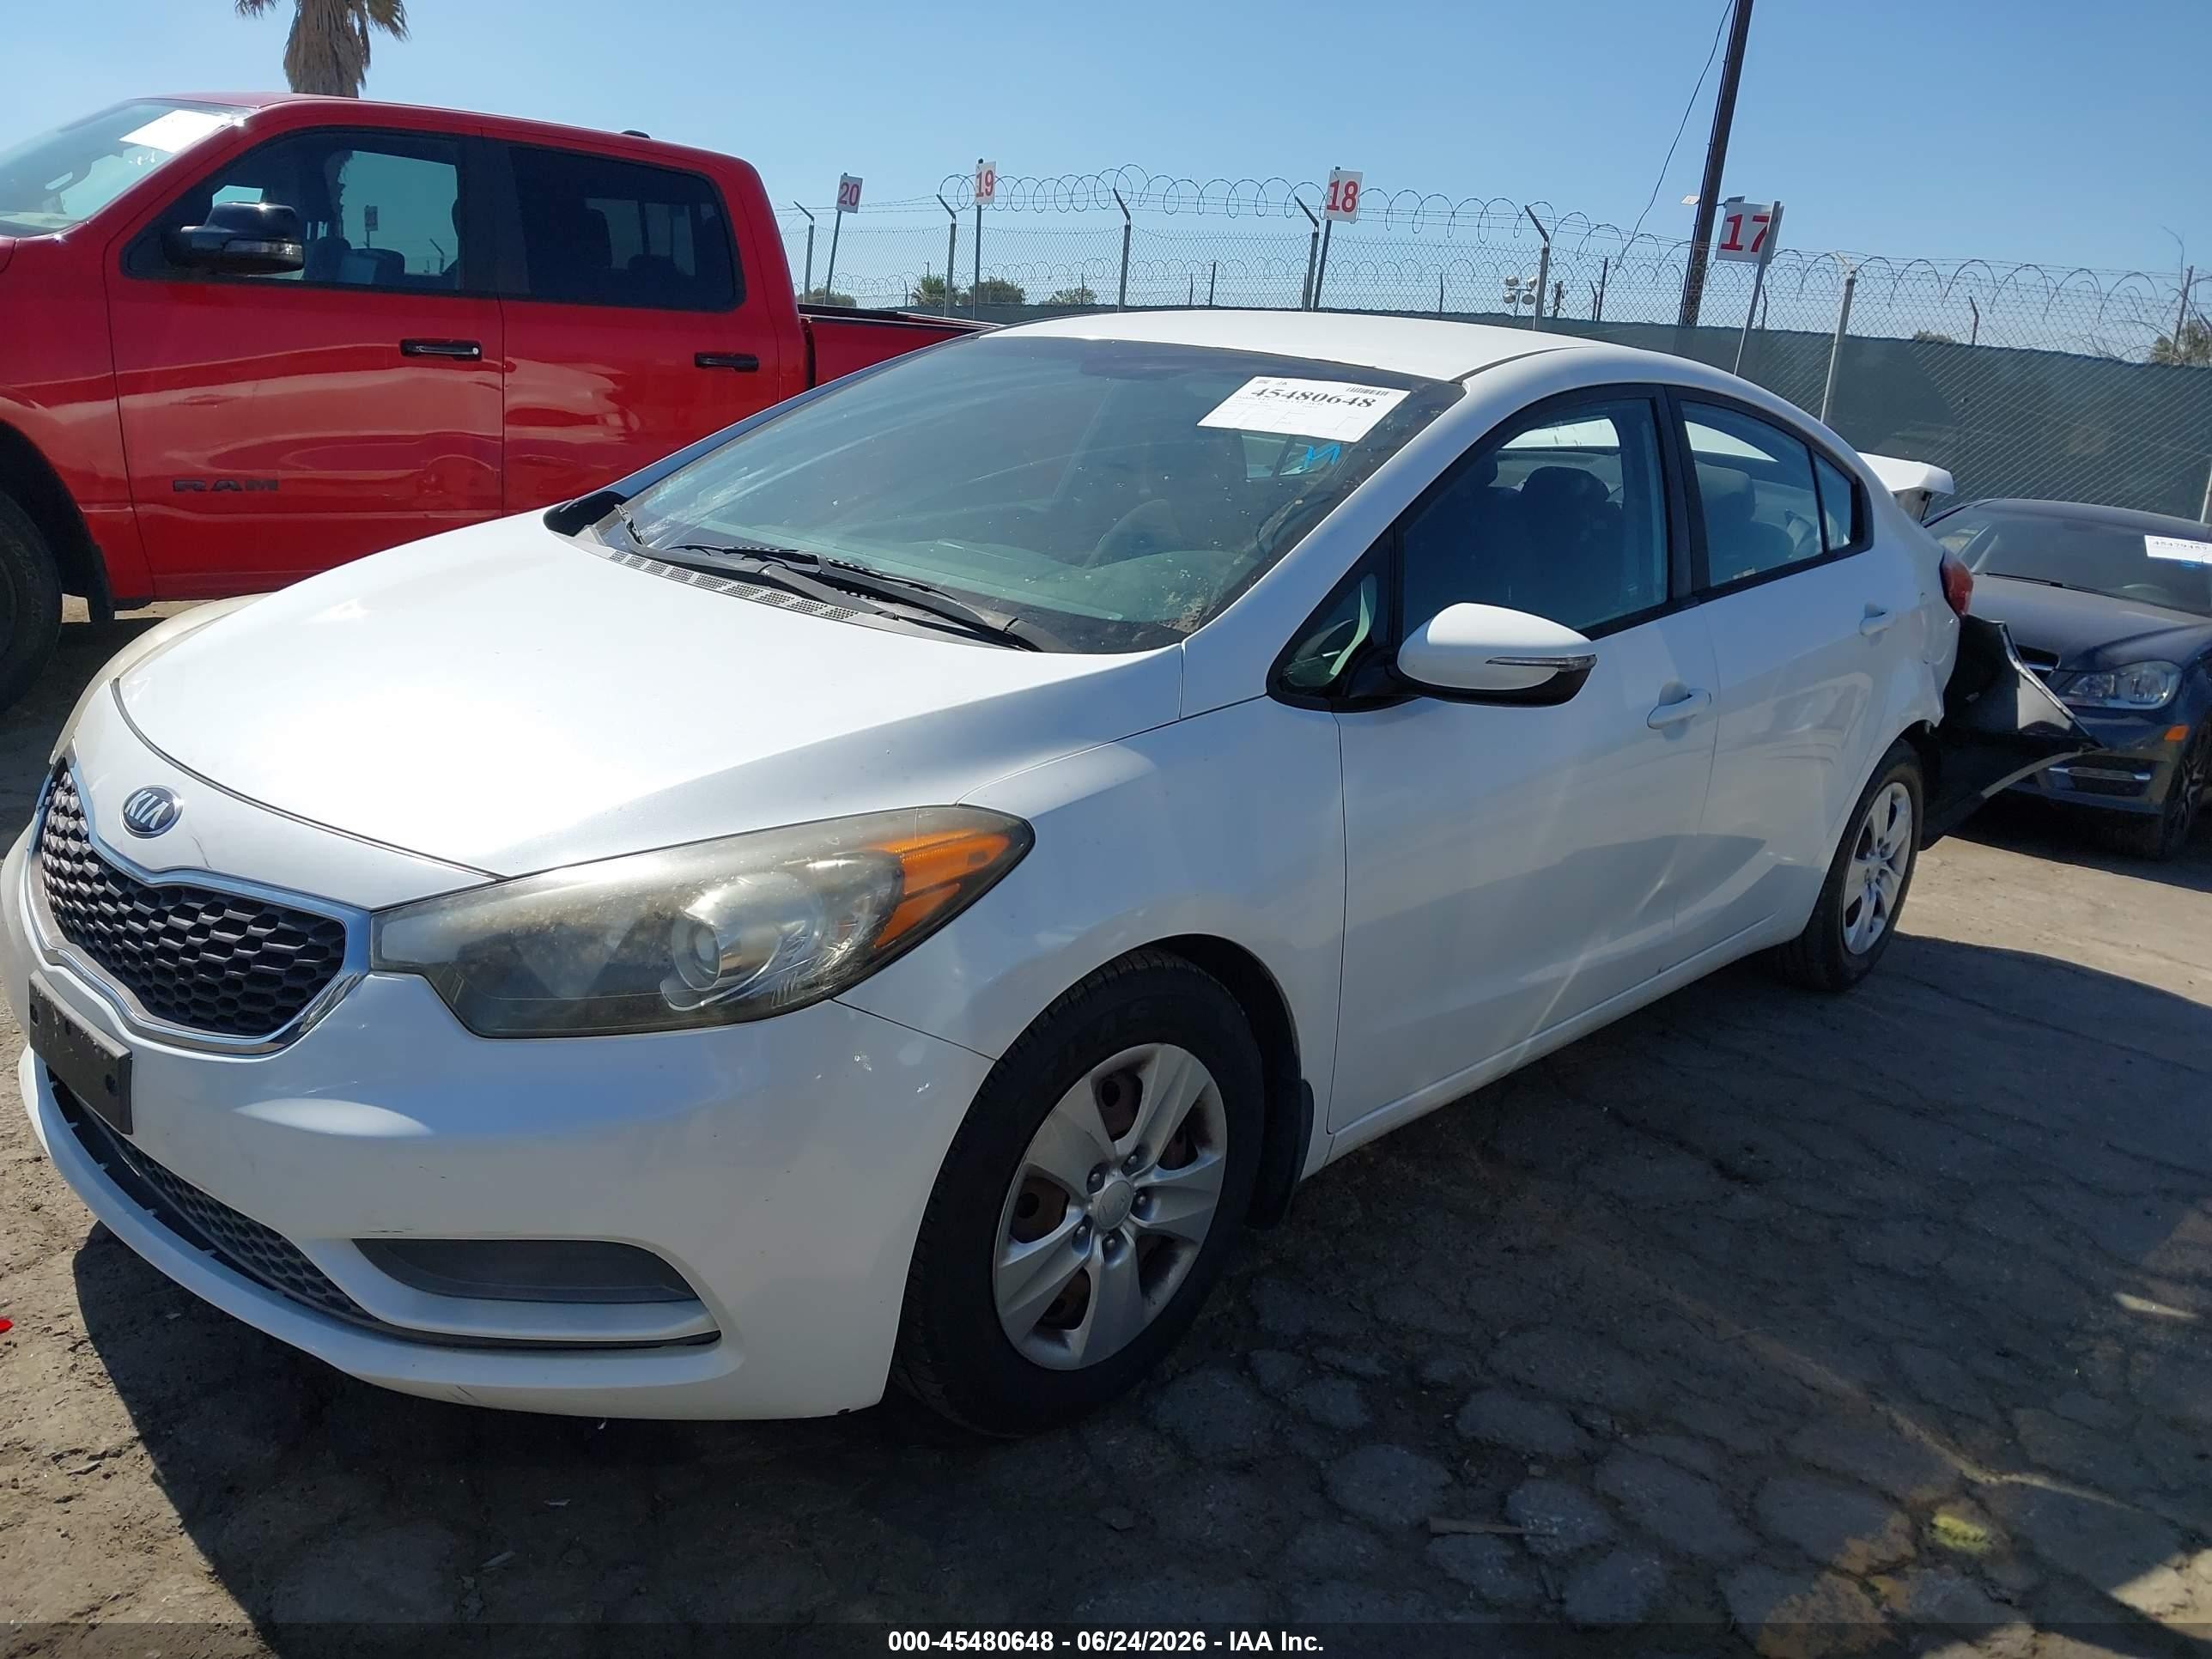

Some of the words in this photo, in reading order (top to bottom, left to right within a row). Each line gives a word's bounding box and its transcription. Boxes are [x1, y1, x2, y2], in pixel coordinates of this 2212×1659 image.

[838, 182, 860, 206] 20
[975, 170, 994, 198] 19
[1327, 179, 1358, 213] 18
[1720, 214, 1771, 252] 17
[1251, 387, 1376, 408] 45480648
[173, 479, 279, 492] RAM
[124, 789, 170, 830] KIA
